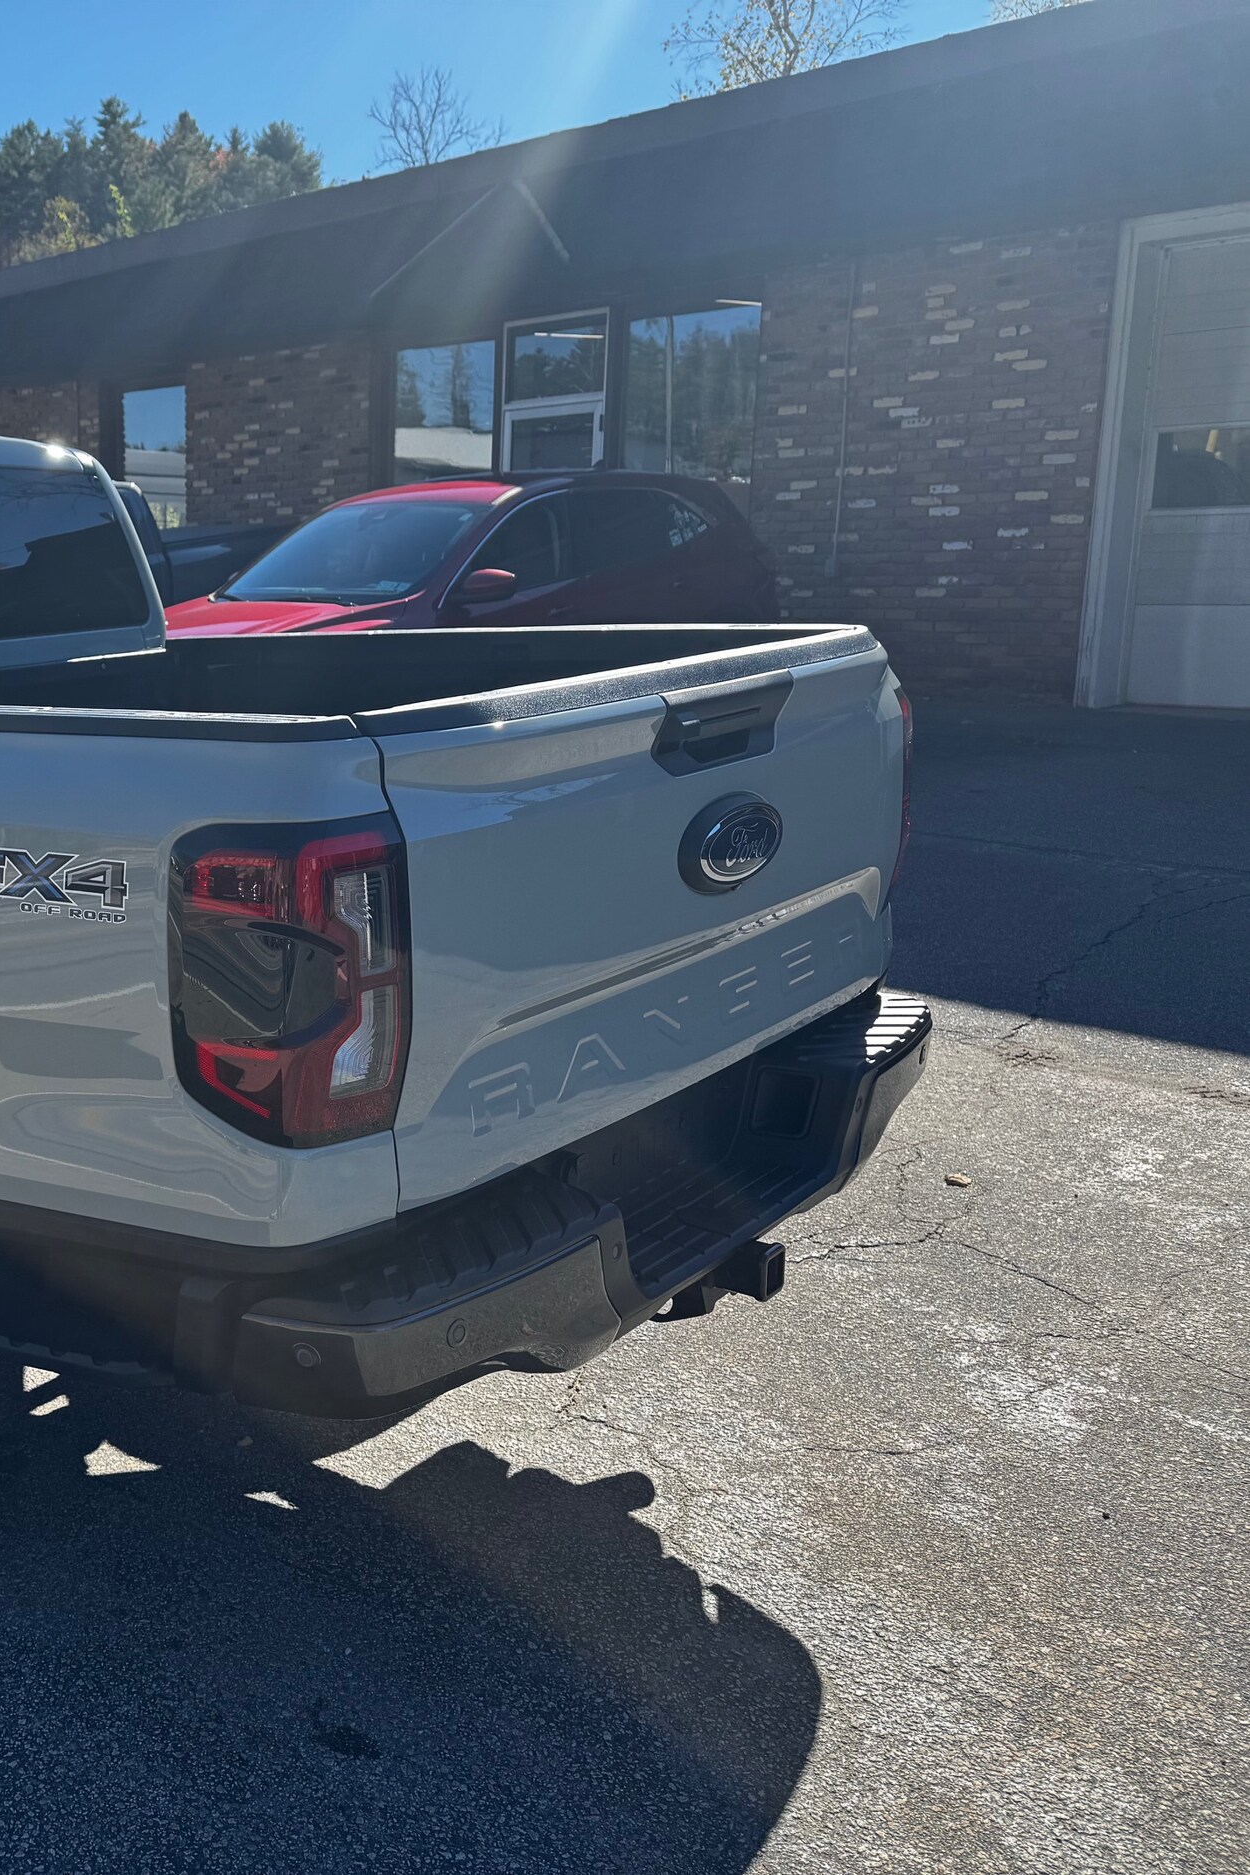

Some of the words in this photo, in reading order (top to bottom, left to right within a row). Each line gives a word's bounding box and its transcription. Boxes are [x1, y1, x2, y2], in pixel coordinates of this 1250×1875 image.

[725, 822, 769, 868] Ford
[19, 902, 61, 916] OFF
[68, 907, 127, 924] ROAD
